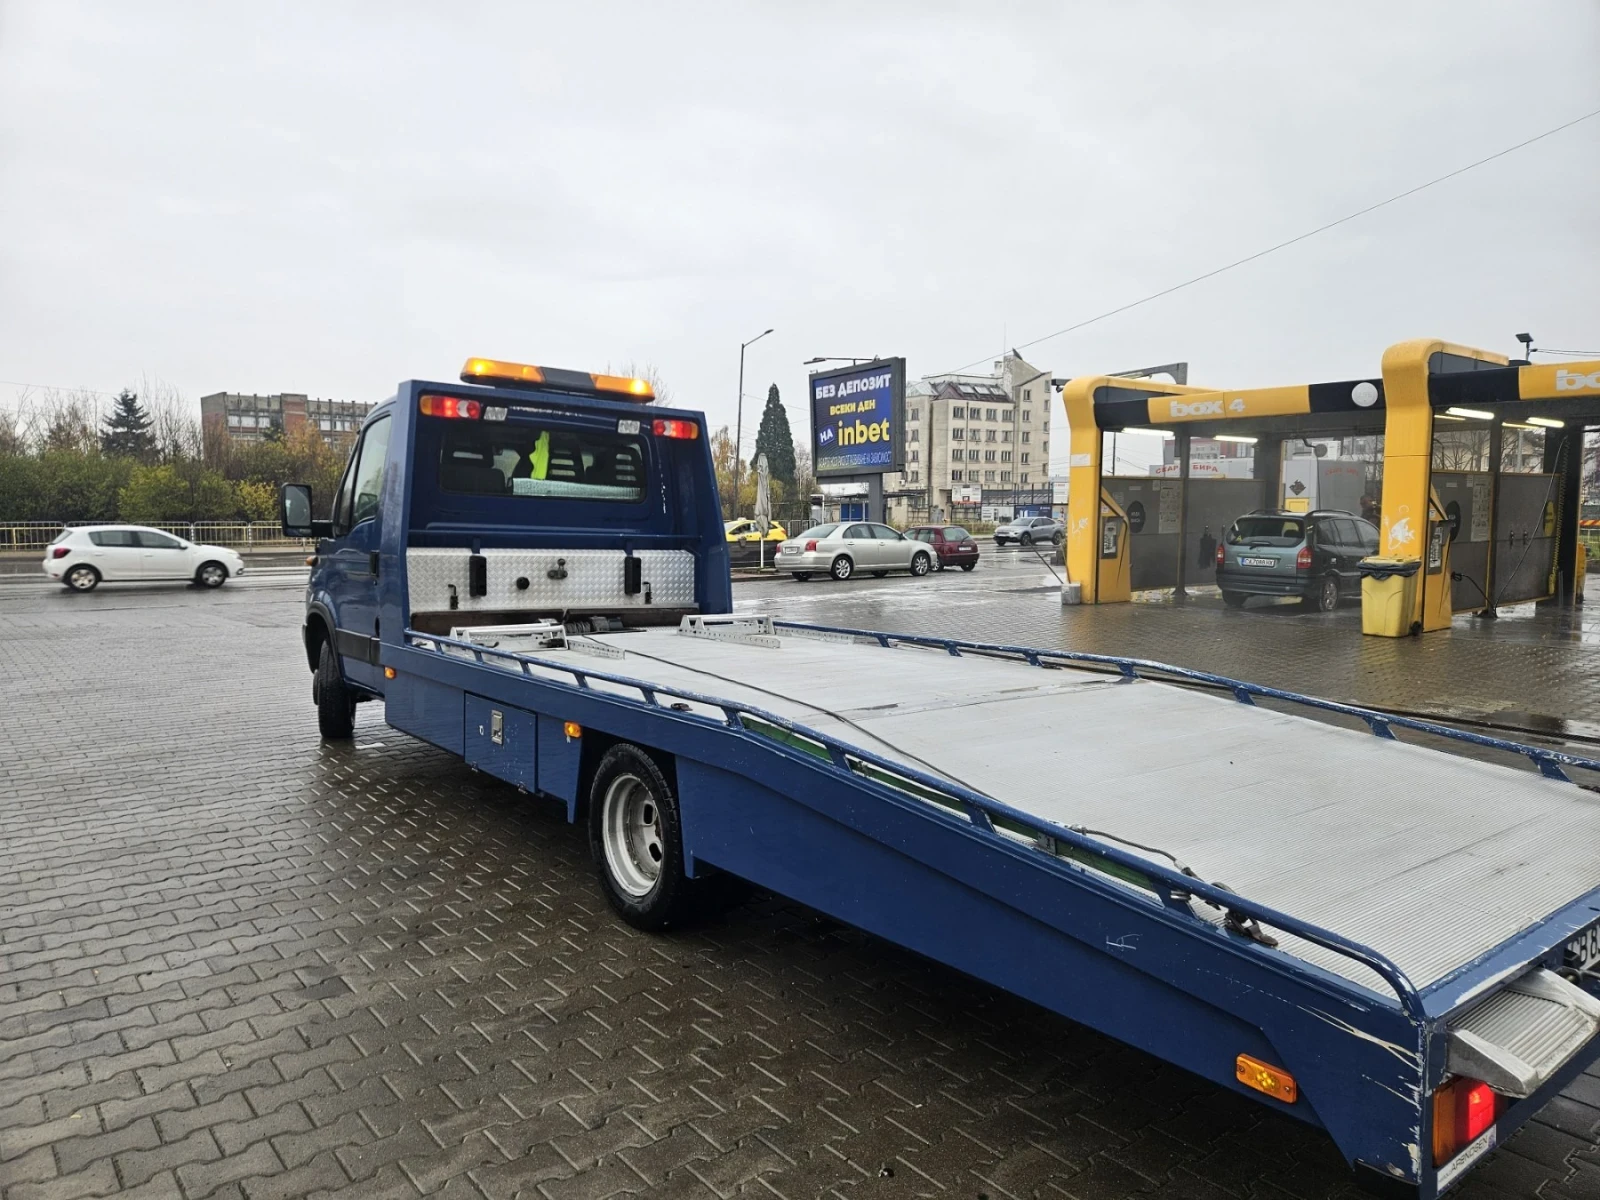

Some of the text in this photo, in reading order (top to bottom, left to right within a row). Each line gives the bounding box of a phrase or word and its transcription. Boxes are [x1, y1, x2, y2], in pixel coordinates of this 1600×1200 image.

[816, 374, 892, 399] БЕЗ ДЕПОЗИТ
[829, 399, 876, 416] ВСЕКИ ДЕН
[1170, 398, 1246, 417] box 4
[820, 428, 834, 443] НА
[838, 417, 890, 446] inbet
[1155, 464, 1218, 474] СКАР БИРА
